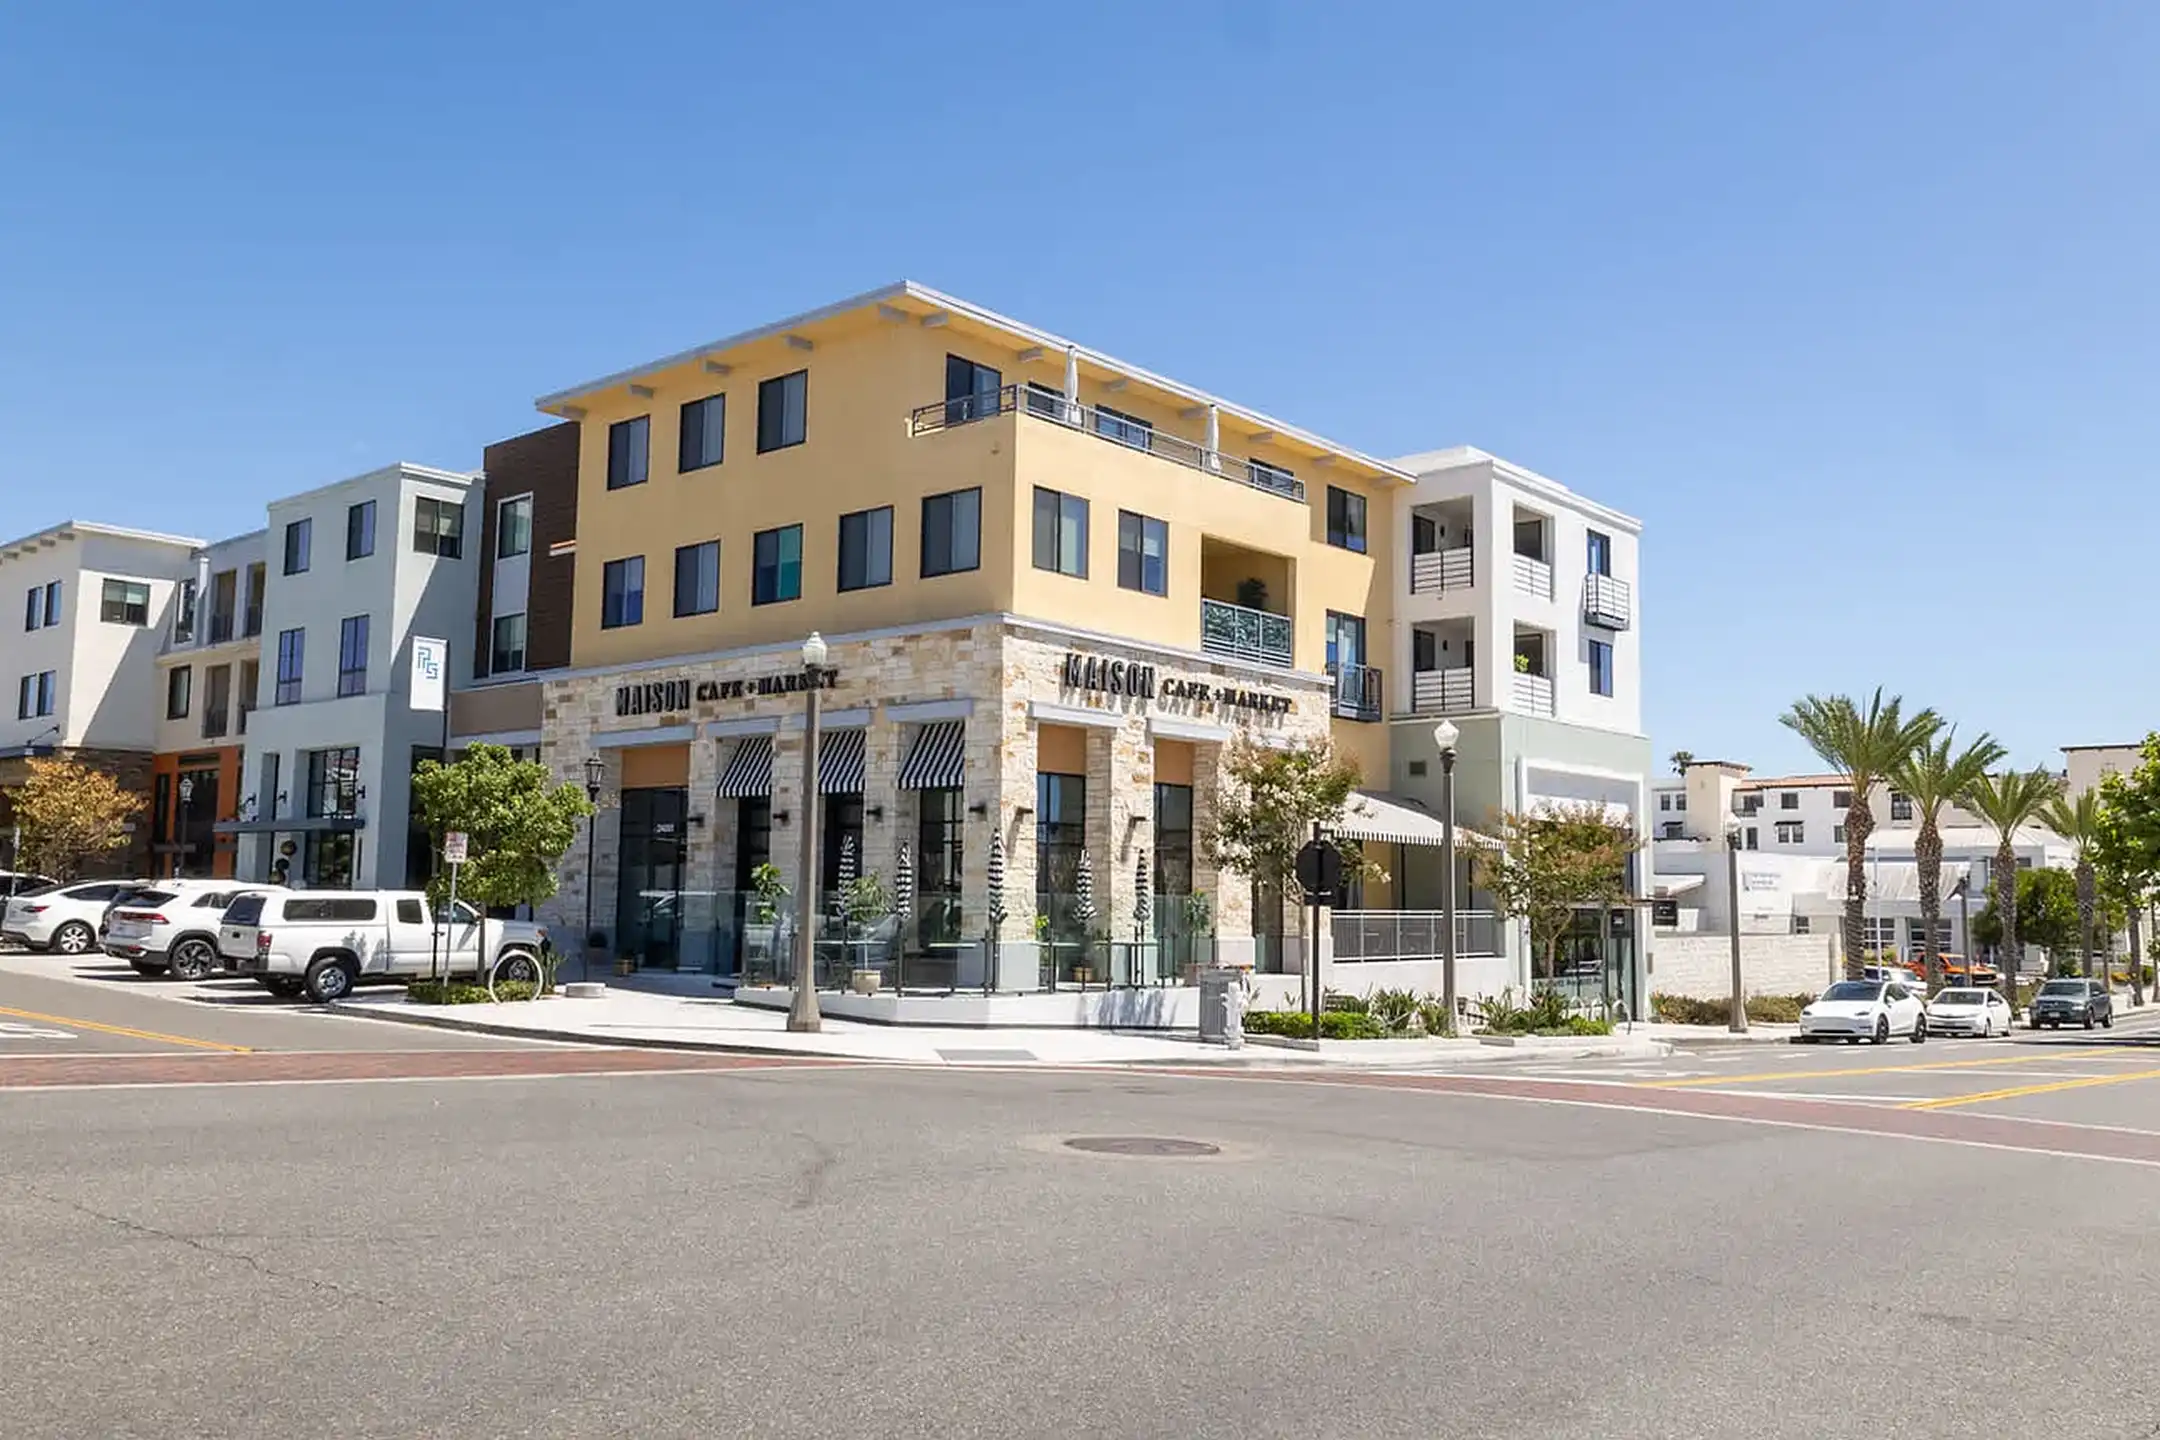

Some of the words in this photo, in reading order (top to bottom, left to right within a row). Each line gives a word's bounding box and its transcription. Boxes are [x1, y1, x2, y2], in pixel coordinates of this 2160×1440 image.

[616, 679, 691, 717] MAISON
[758, 668, 838, 696] MARKT
[1064, 652, 1156, 700] MAISON
[1223, 687, 1293, 713] MARKET
